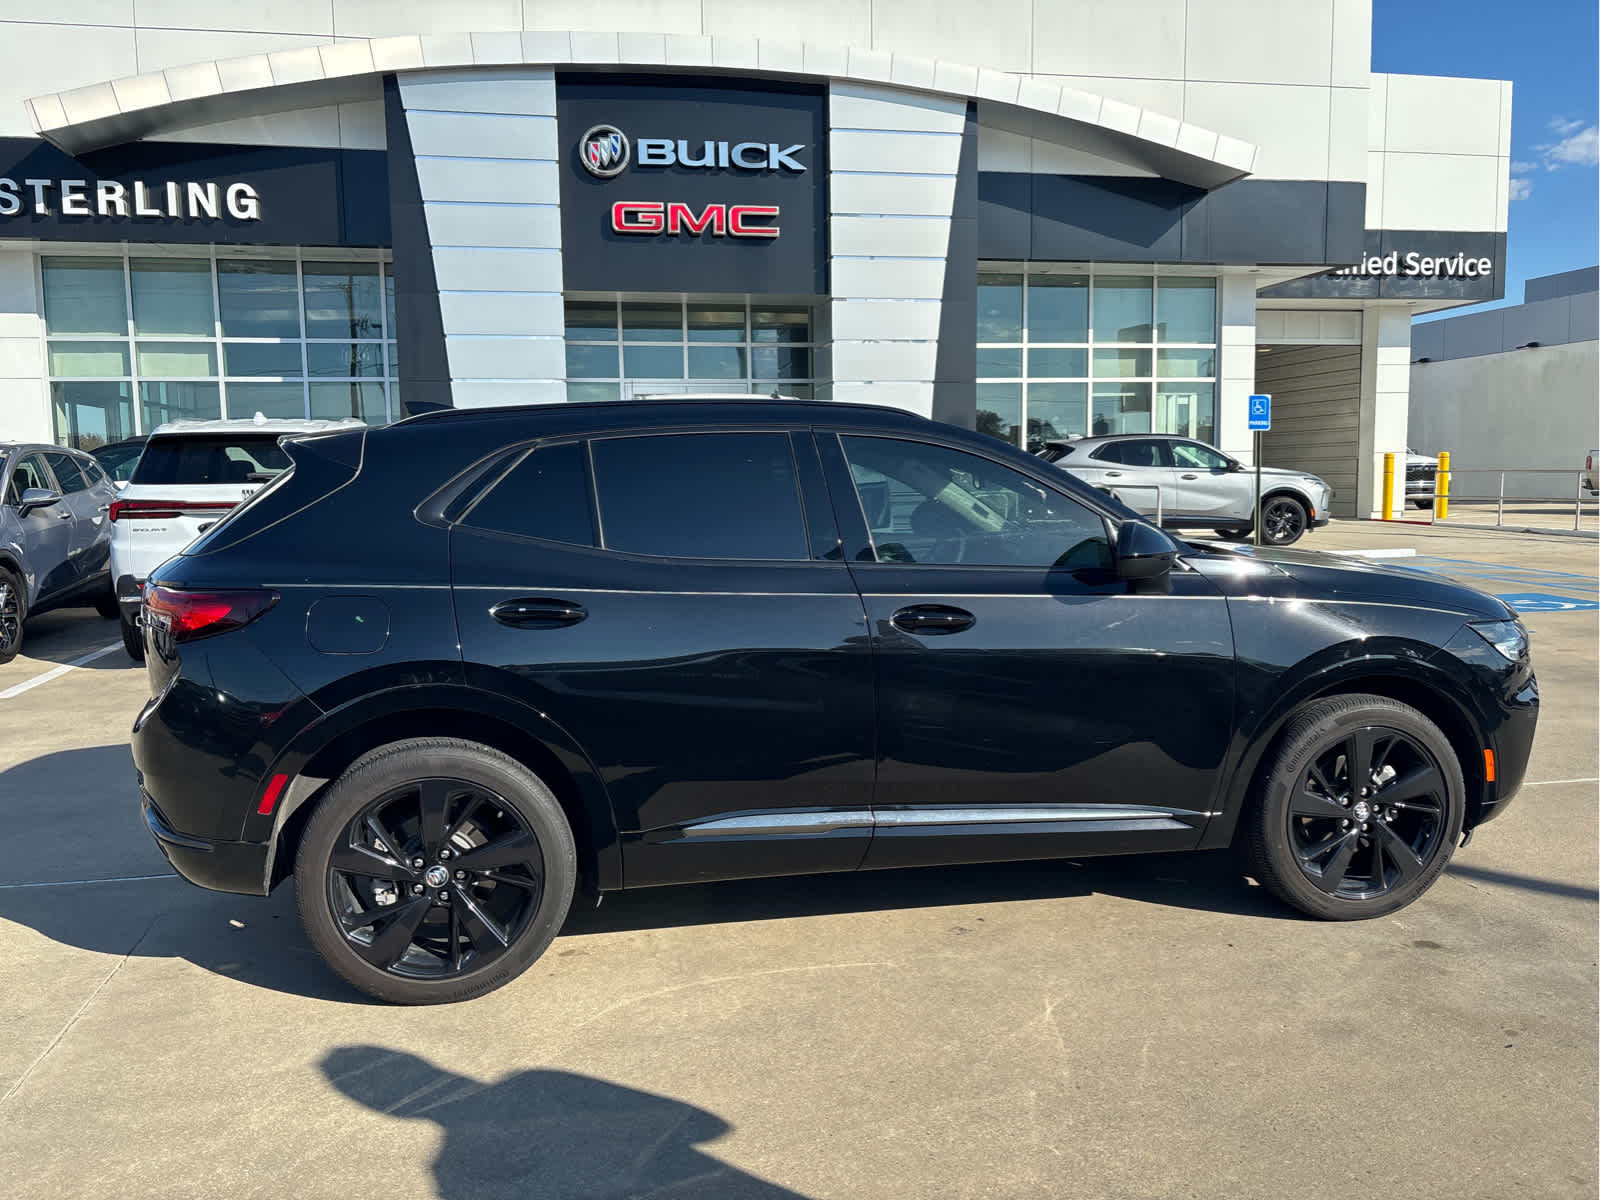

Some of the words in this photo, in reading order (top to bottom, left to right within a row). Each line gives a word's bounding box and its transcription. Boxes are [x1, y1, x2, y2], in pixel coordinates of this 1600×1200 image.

[637, 138, 807, 172] BUICK
[0, 177, 261, 220] STERLING
[612, 201, 781, 238] GMC
[1405, 251, 1492, 276] Service
